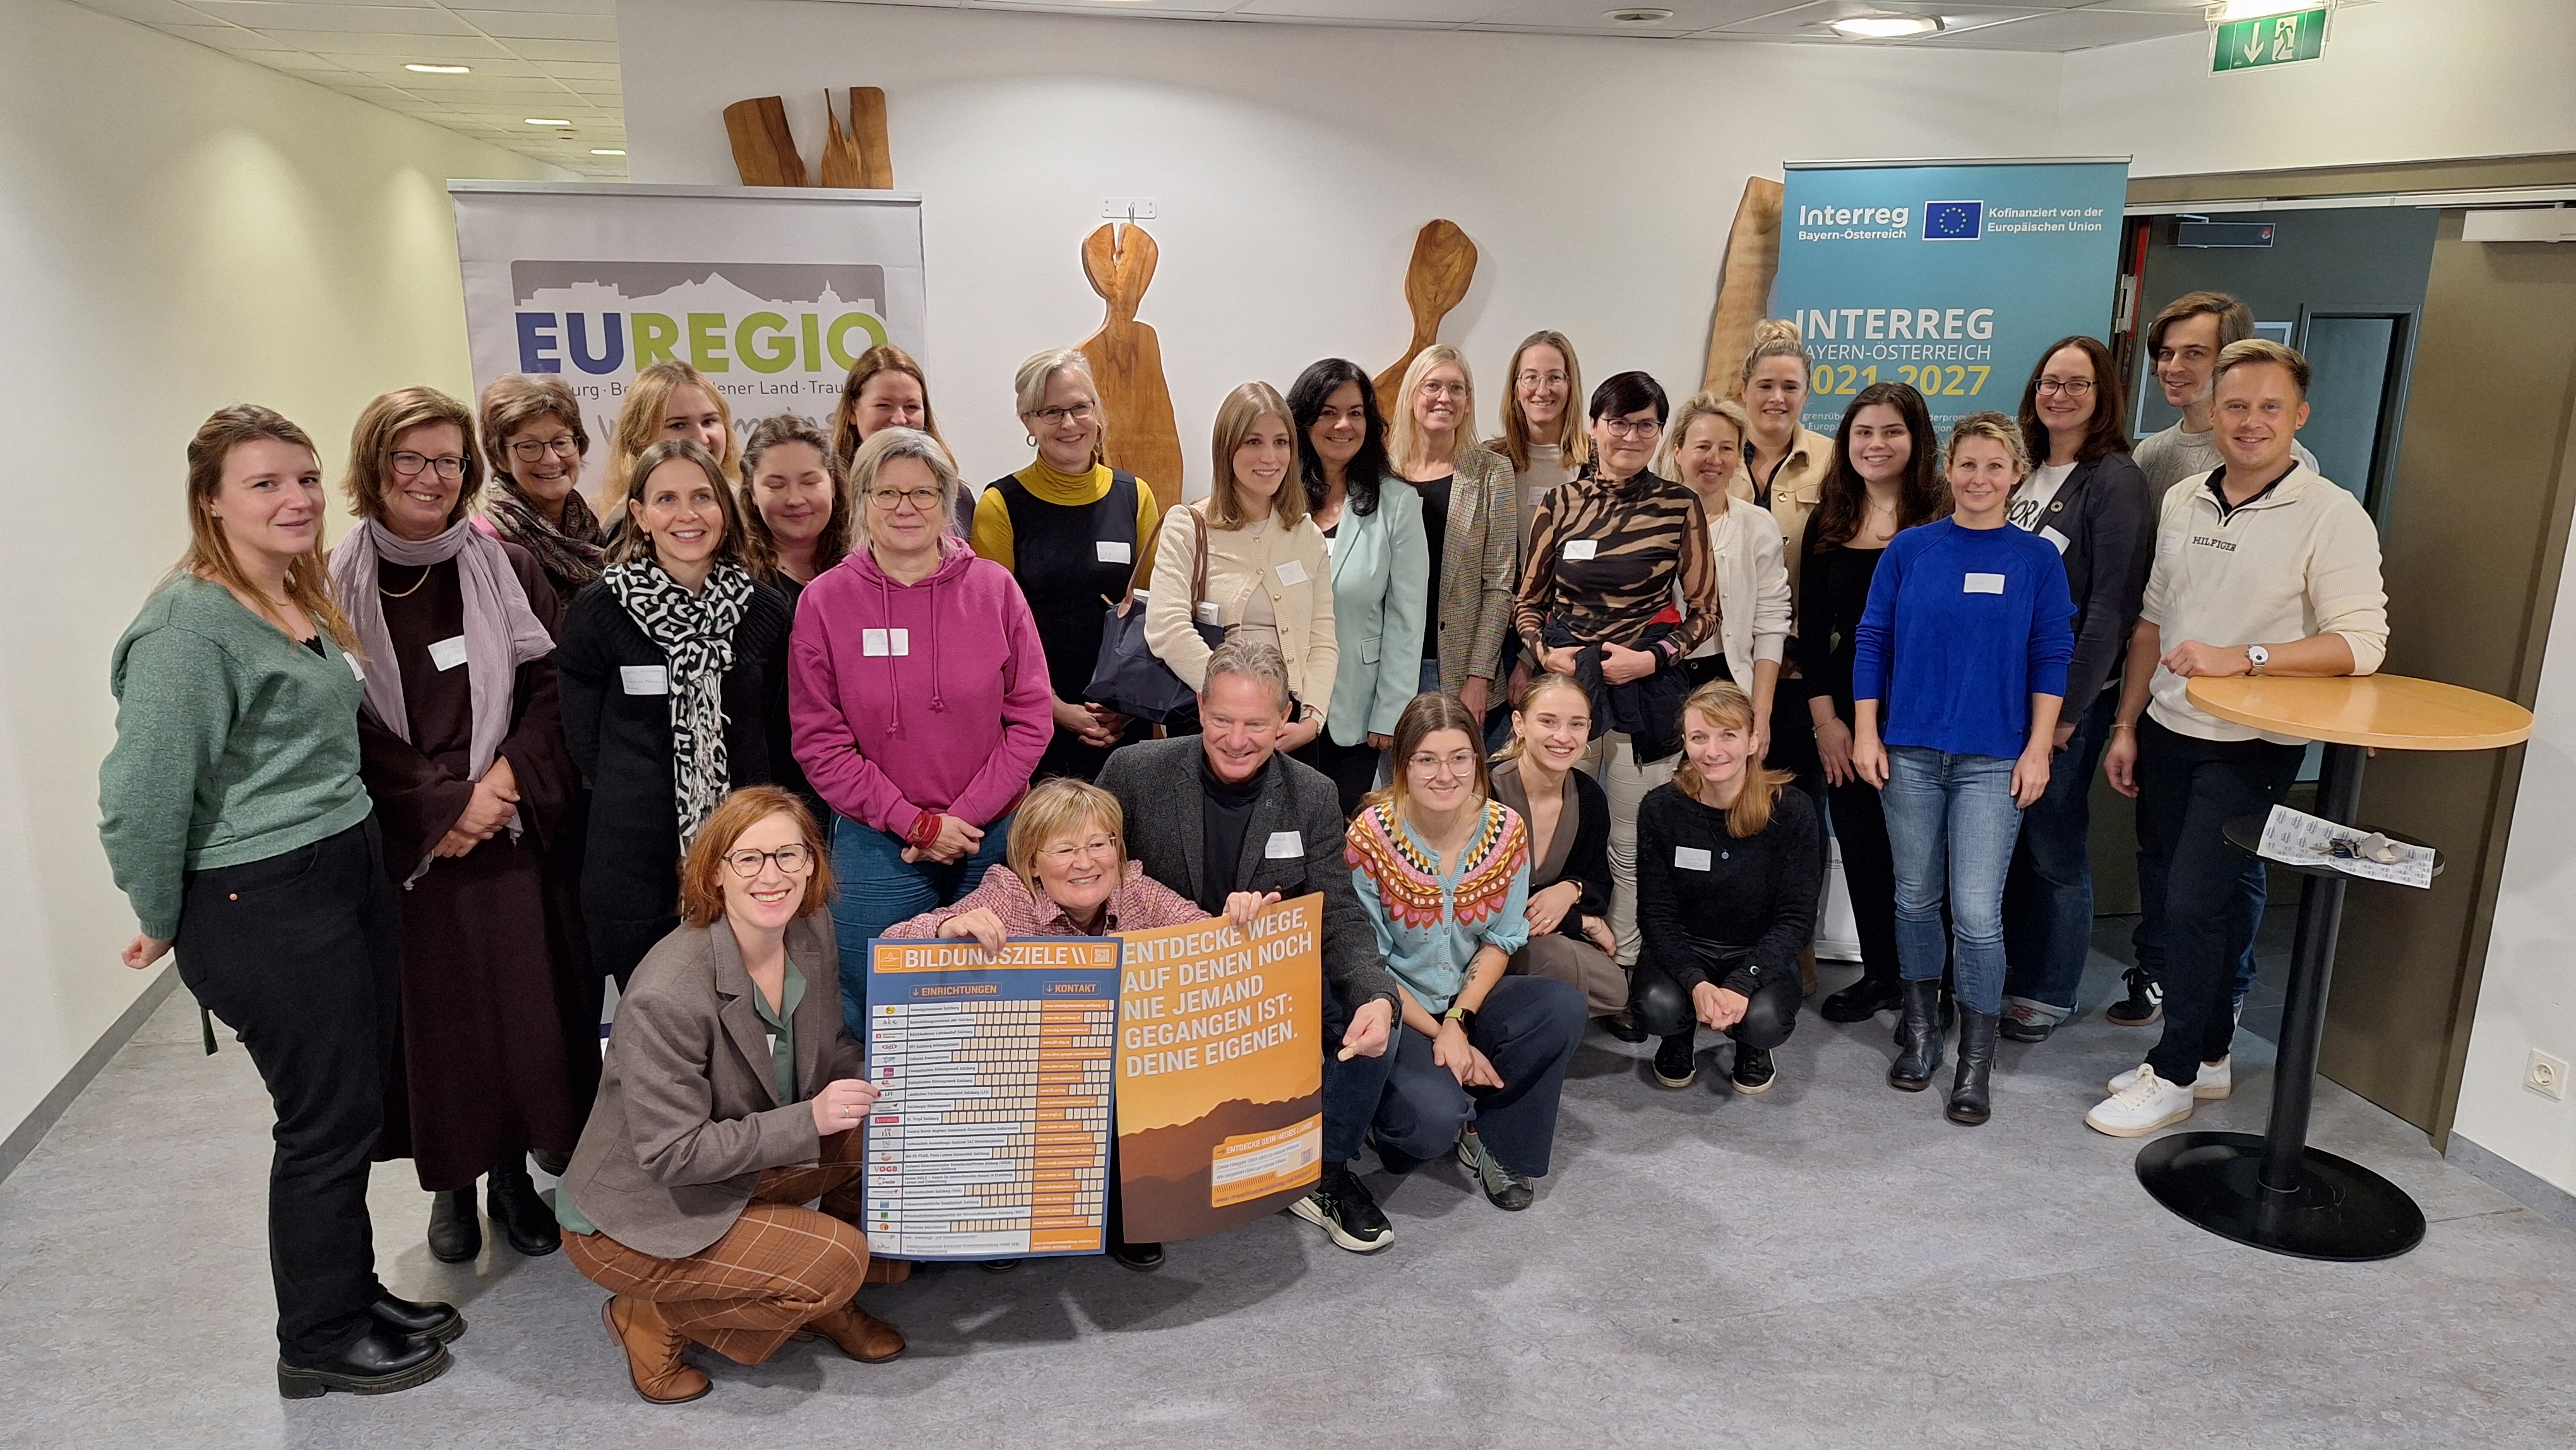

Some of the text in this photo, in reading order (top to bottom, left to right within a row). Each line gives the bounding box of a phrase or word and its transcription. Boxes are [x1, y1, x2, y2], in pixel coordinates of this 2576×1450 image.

[1799, 205, 1909, 228] Interreg
[1989, 207, 2104, 218] Kofinanziert von der
[1798, 228, 1907, 243] Bayern-Österreich
[1987, 220, 2102, 234] Europäischen Union
[1795, 308, 1995, 340] INTERREG
[515, 311, 889, 374] EUREGIO
[1805, 341, 1991, 361] AYERN-ÖSTERREICH
[760, 381, 799, 395] Land
[2191, 536, 2237, 552] HILFIGER
[1122, 907, 1309, 965] ENTDECKE WEGE,
[1123, 932, 1312, 993] AUF DENEN NOCH
[921, 985, 997, 996] EINRICHTUNGEN
[1054, 984, 1097, 993] KONTAKT
[1124, 974, 1263, 1021] NIE JEMAND
[1125, 993, 1293, 1050] GEGANGEN IST:
[1126, 1019, 1298, 1077] DEINE EIGENEN.
[1225, 1139, 1261, 1154] ENTDECKE
[1261, 1134, 1277, 1146] DEIN
